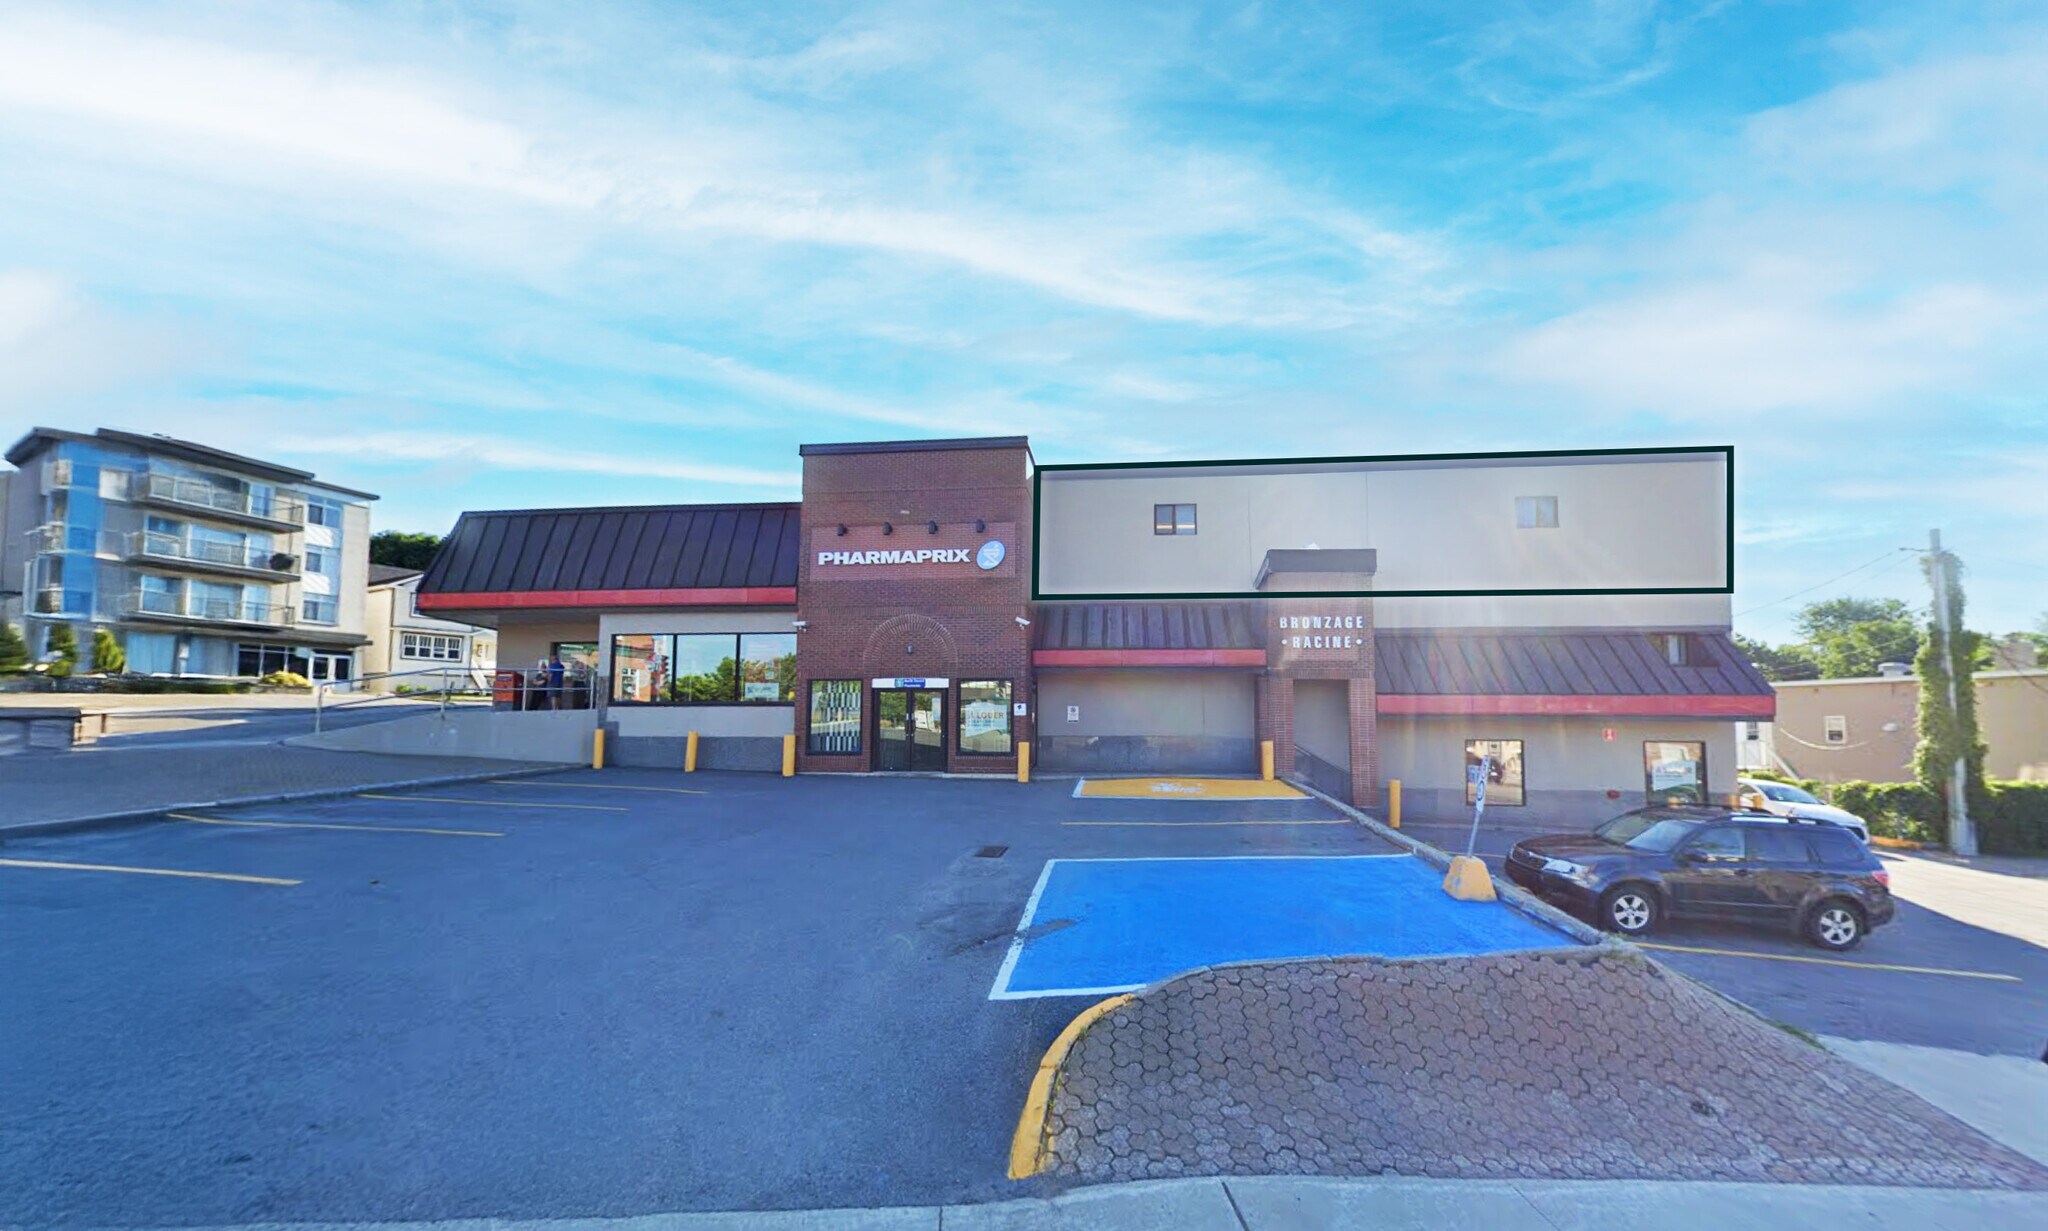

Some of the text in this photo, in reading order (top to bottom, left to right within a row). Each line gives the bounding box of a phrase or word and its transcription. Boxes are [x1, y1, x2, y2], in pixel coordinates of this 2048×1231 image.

[818, 549, 970, 565] PHARMAPRIX
[1280, 616, 1364, 629] BRONZAGE
[1292, 636, 1351, 648] RACINE
[977, 711, 1005, 719] LOUER
